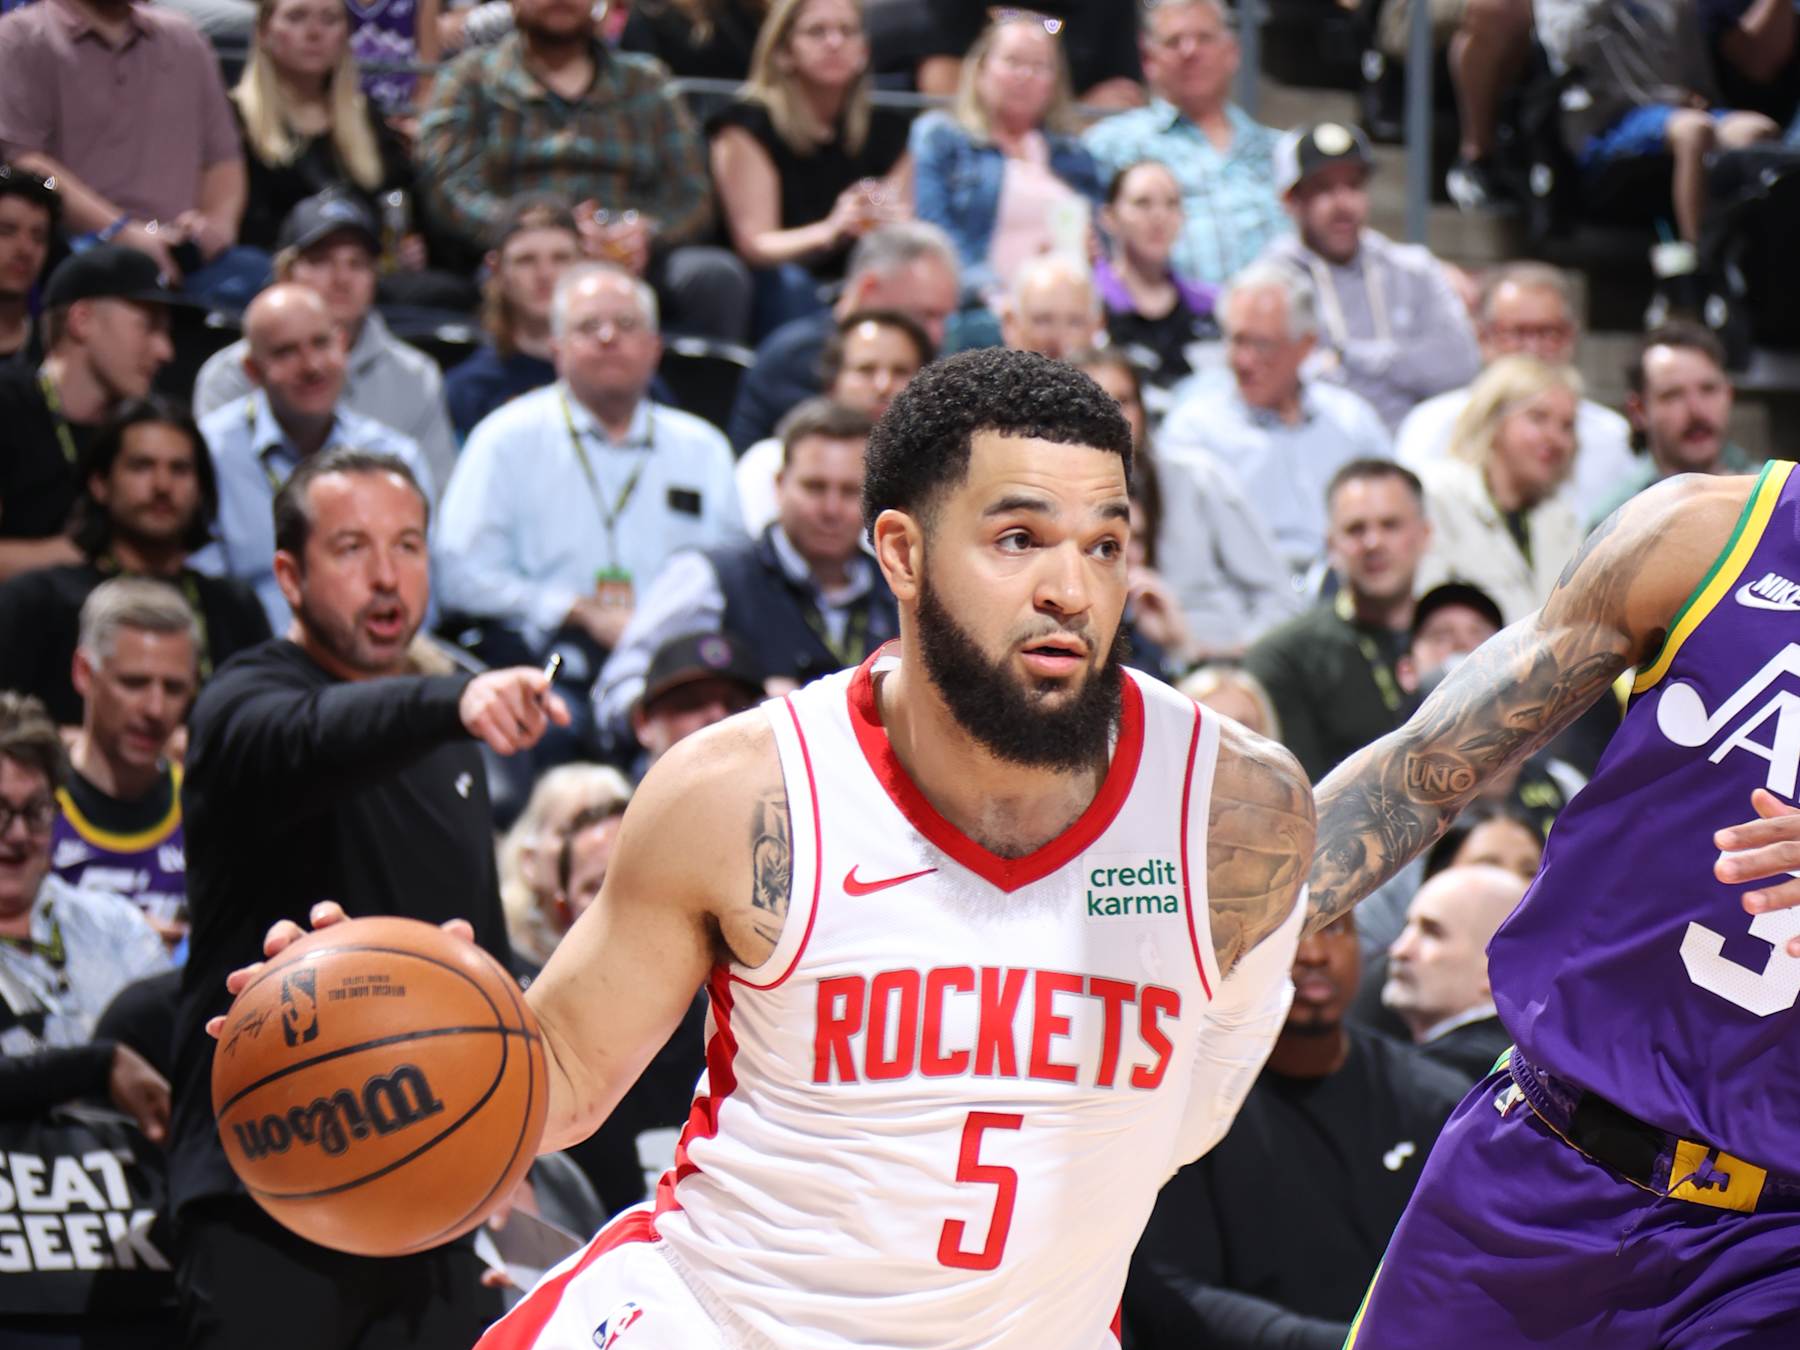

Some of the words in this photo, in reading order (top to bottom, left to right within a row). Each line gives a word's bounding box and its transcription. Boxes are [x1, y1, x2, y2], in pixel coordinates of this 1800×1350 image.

[1408, 758, 1476, 793] UNO
[1087, 889, 1179, 917] karma
[1090, 858, 1177, 888] credit
[811, 965, 1182, 1090] ROCKETS
[233, 1063, 445, 1162] Wilson
[936, 1110, 1025, 1271] 5
[0, 1208, 173, 1273] GEEK
